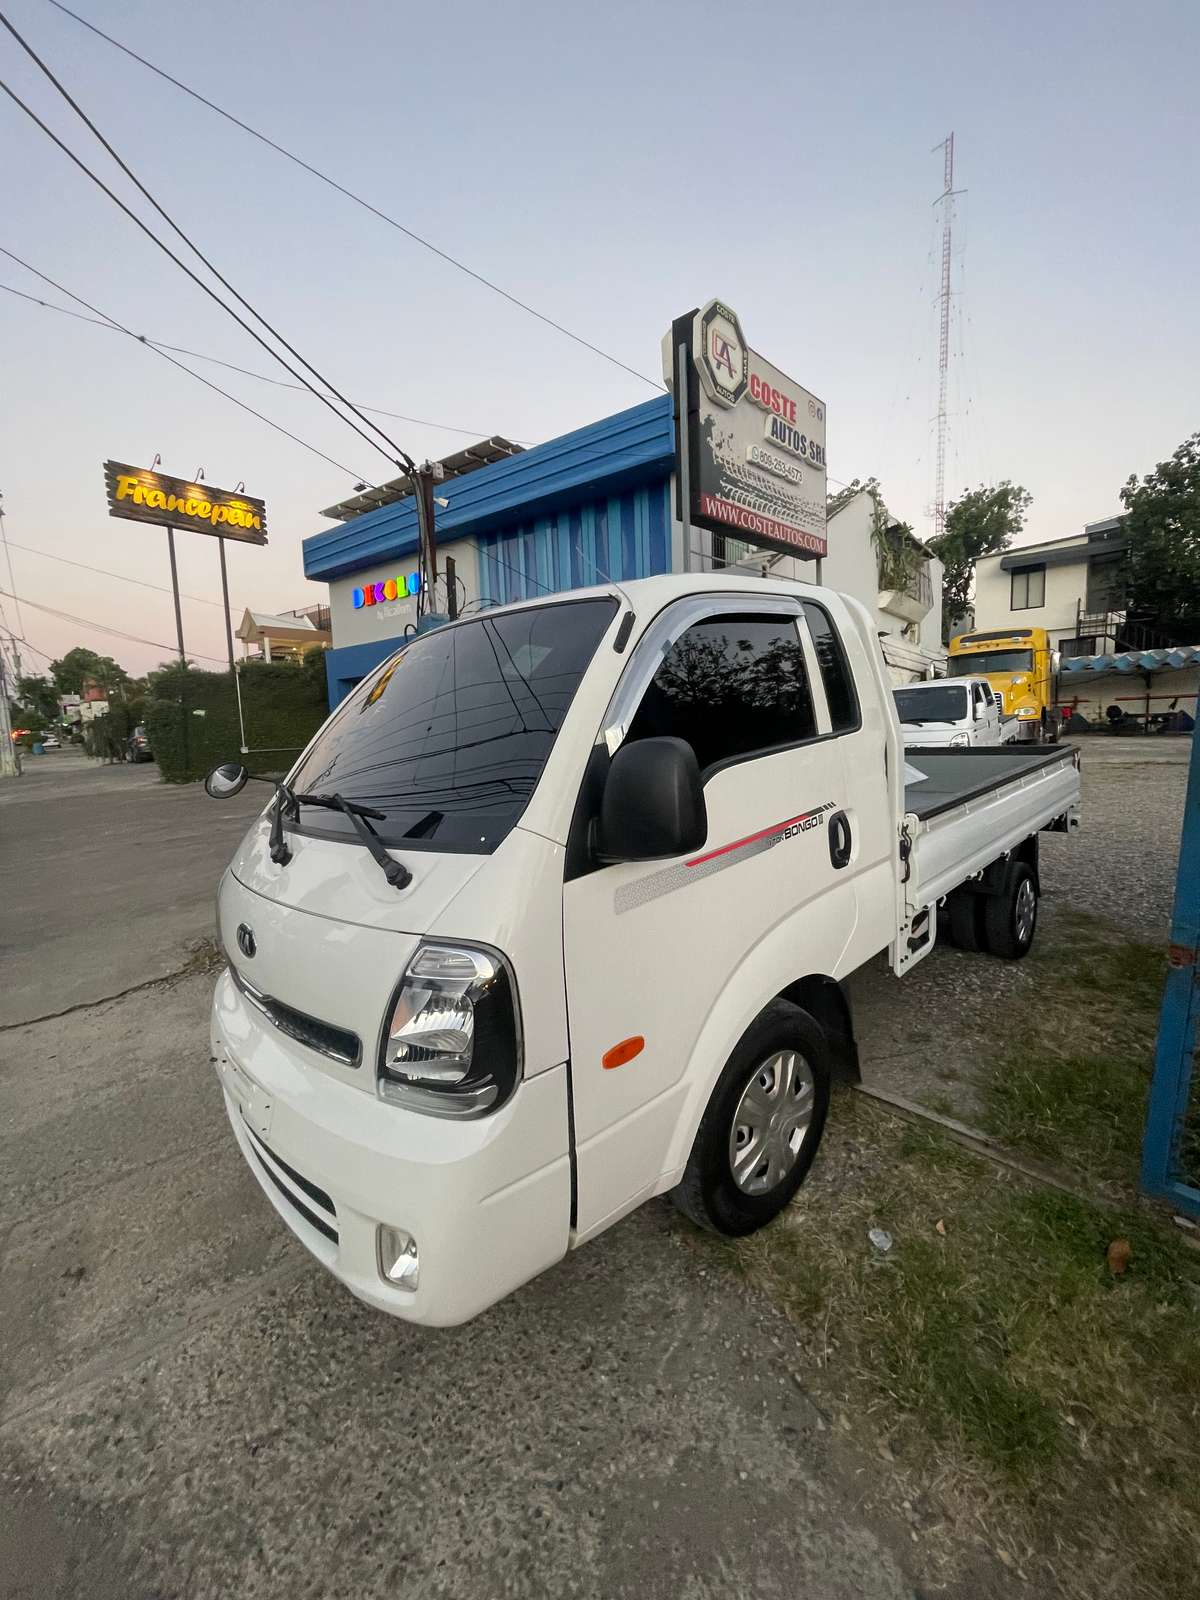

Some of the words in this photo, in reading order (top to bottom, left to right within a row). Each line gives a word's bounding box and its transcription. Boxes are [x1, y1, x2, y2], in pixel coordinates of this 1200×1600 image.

[750, 373, 797, 424] COSTE
[771, 416, 807, 456] AUTOS
[705, 497, 824, 554] WWW.COSTEAUTOS.COM
[784, 816, 818, 840] BONGO
